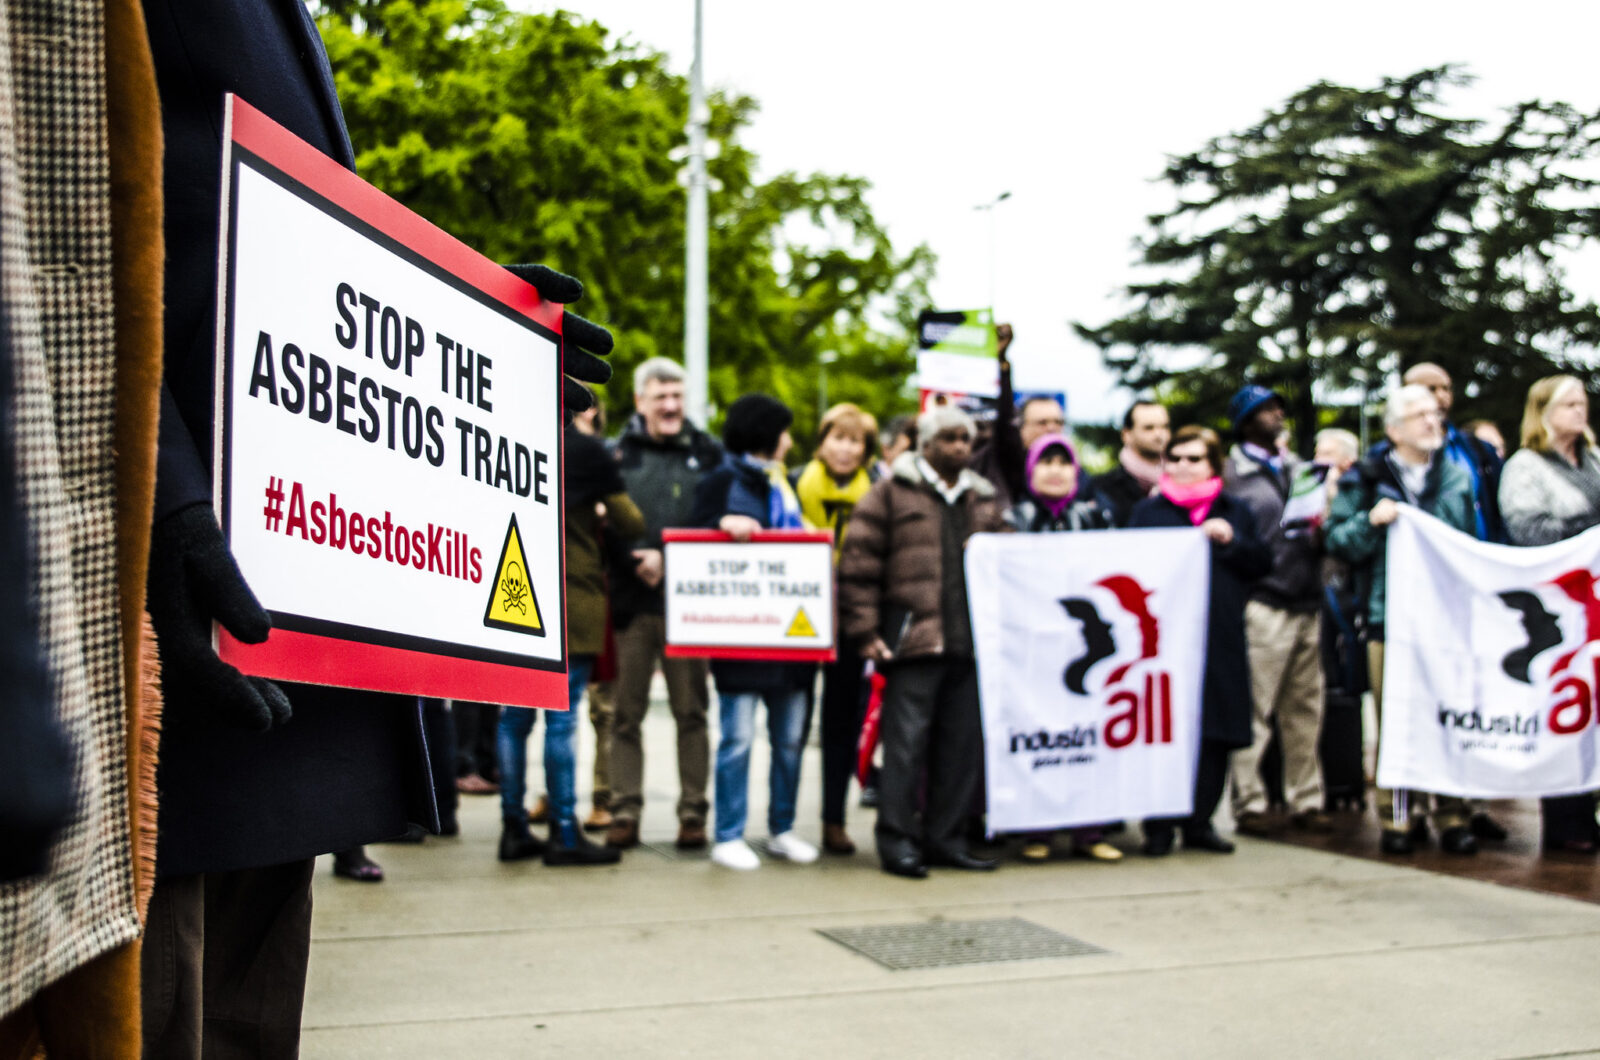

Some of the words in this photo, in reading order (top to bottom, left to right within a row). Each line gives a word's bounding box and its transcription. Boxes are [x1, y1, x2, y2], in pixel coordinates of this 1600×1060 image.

[335, 281, 425, 377] STOP
[435, 331, 493, 414] THE
[248, 330, 445, 468] ASBESTOS
[454, 416, 549, 506] TRADE
[263, 475, 483, 584] #AsbestosKills
[675, 580, 761, 597] ASBESTOS
[769, 581, 822, 598] TRADE
[708, 560, 749, 575] STOP
[758, 560, 786, 576] THE
[1438, 701, 1540, 736] industri
